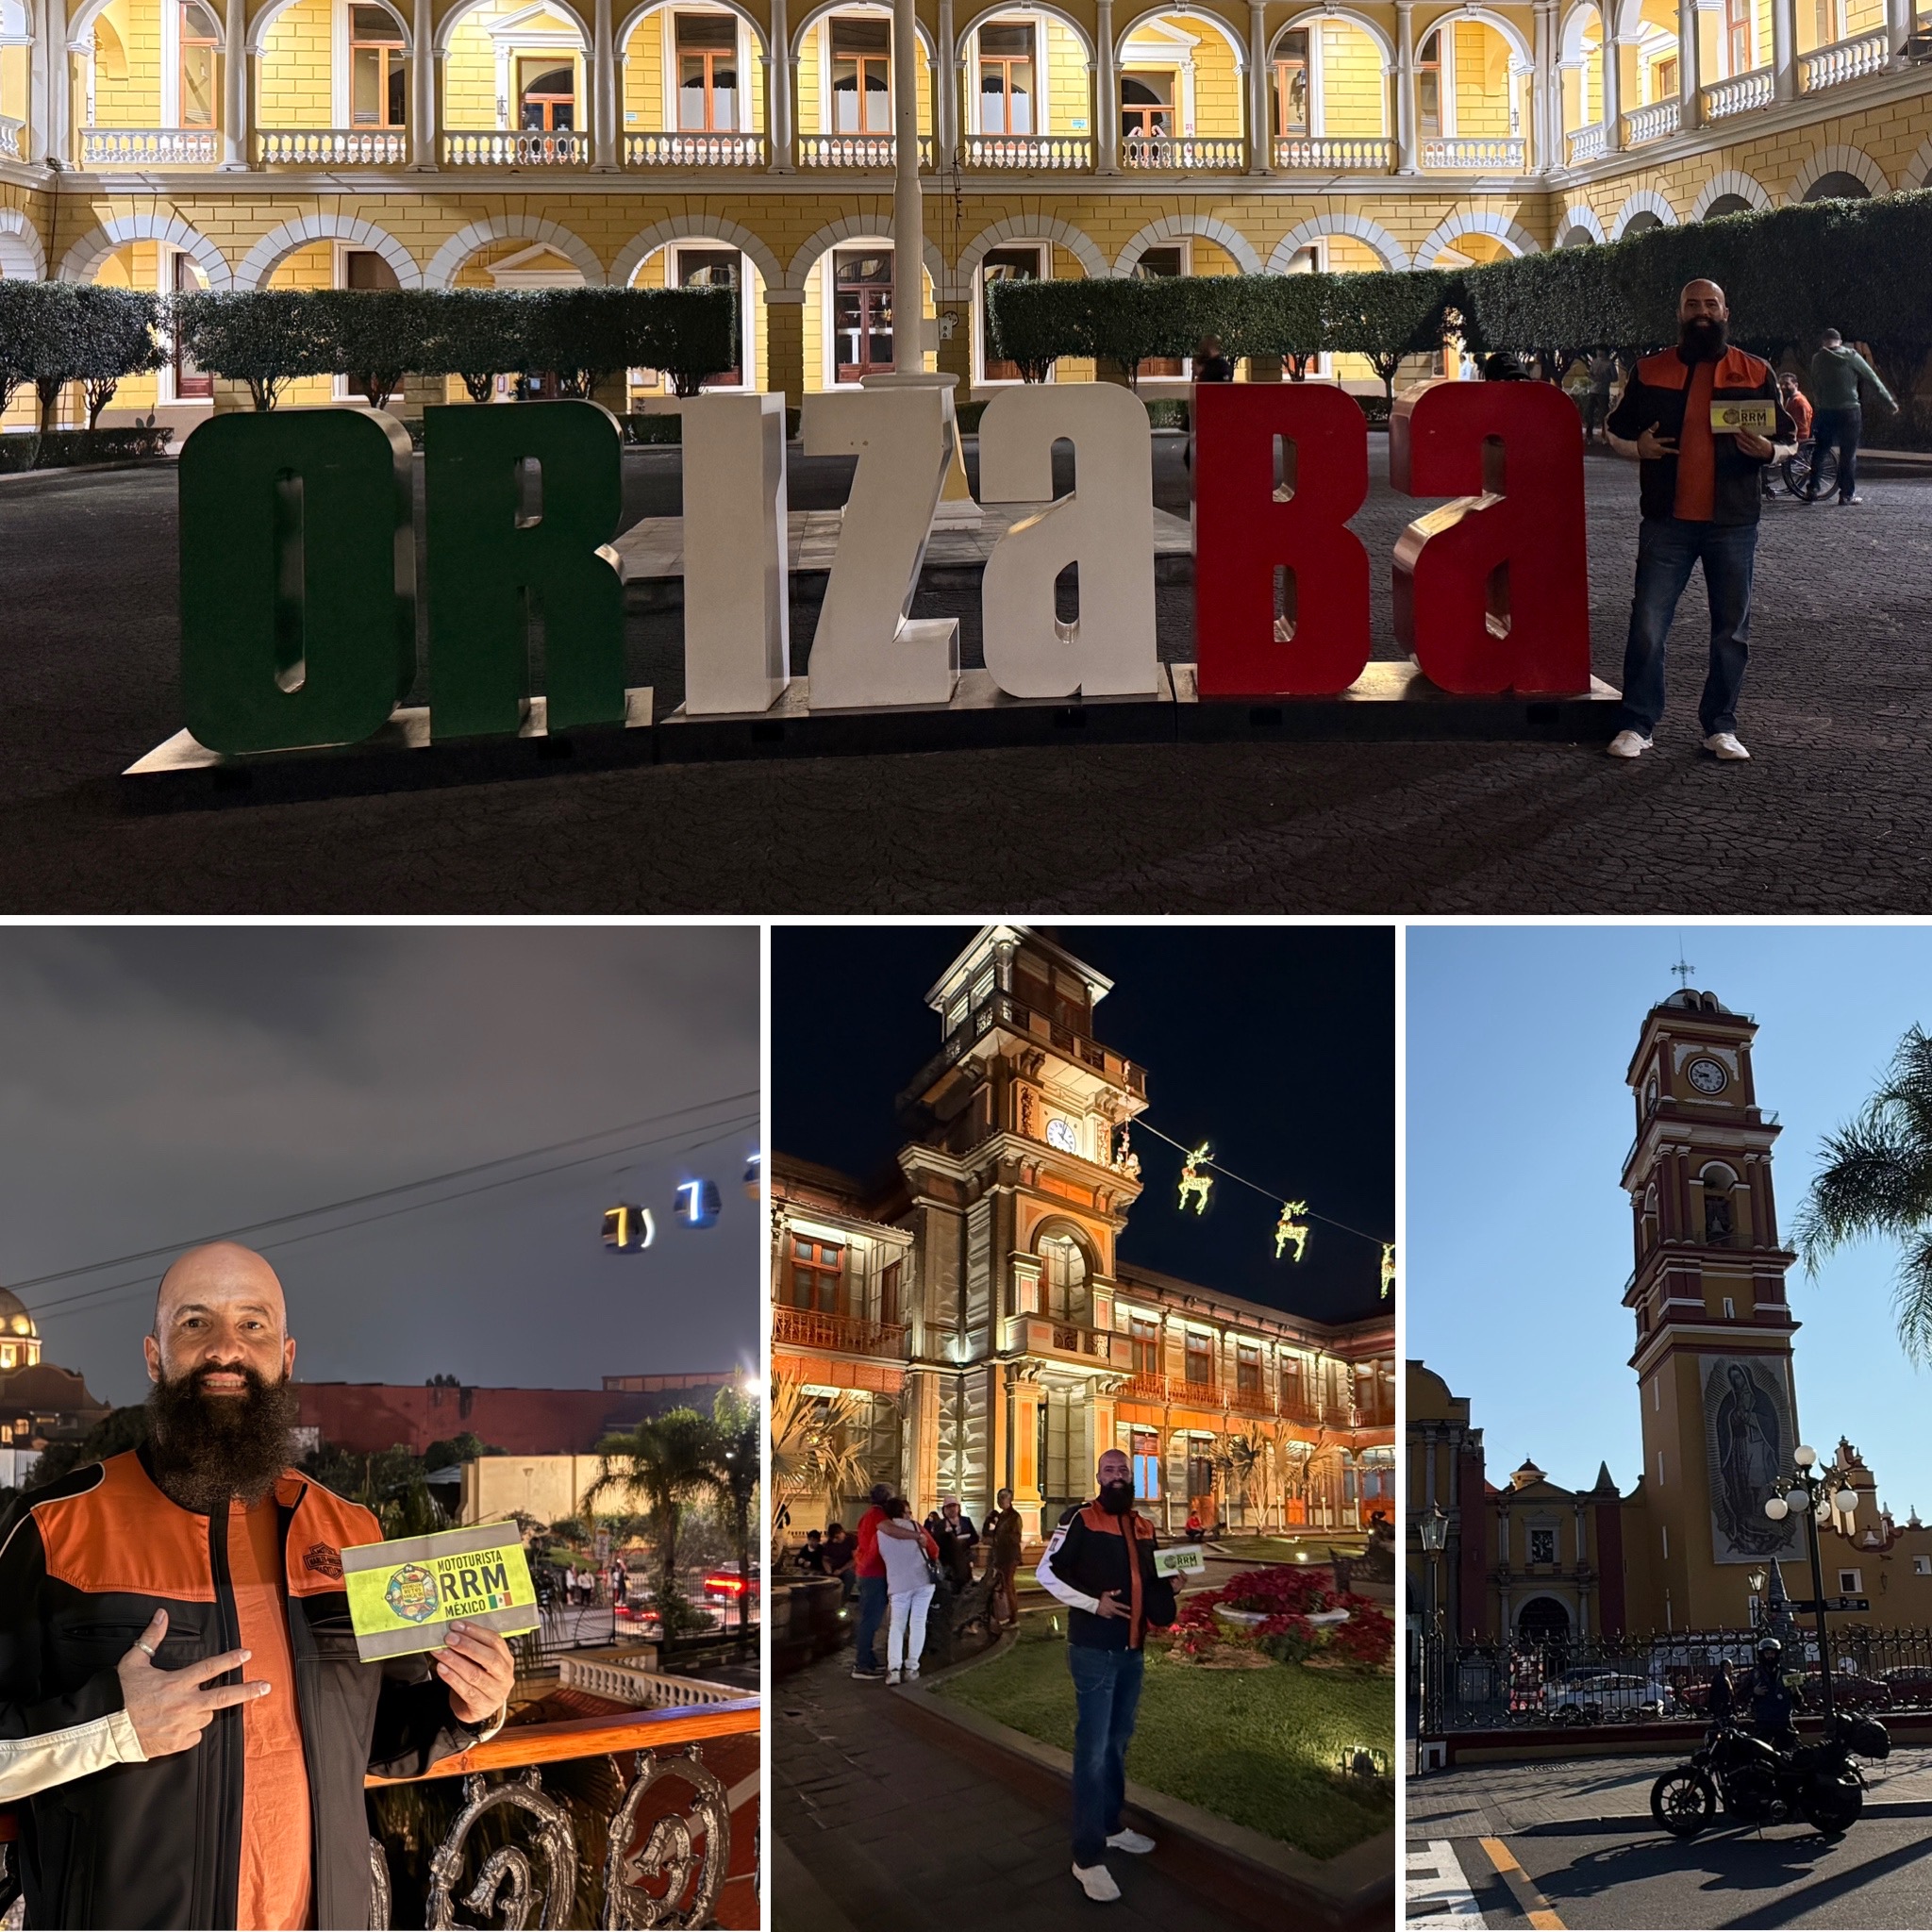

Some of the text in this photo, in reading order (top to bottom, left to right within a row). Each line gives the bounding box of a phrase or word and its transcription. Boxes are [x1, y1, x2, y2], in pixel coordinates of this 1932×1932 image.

[1741, 412, 1766, 422] RRM
[437, 1550, 503, 1573] MOTOTURISTA
[1177, 1556, 1197, 1565] RRM
[440, 1563, 509, 1602] RRM
[445, 1599, 486, 1617] MÉXICO
